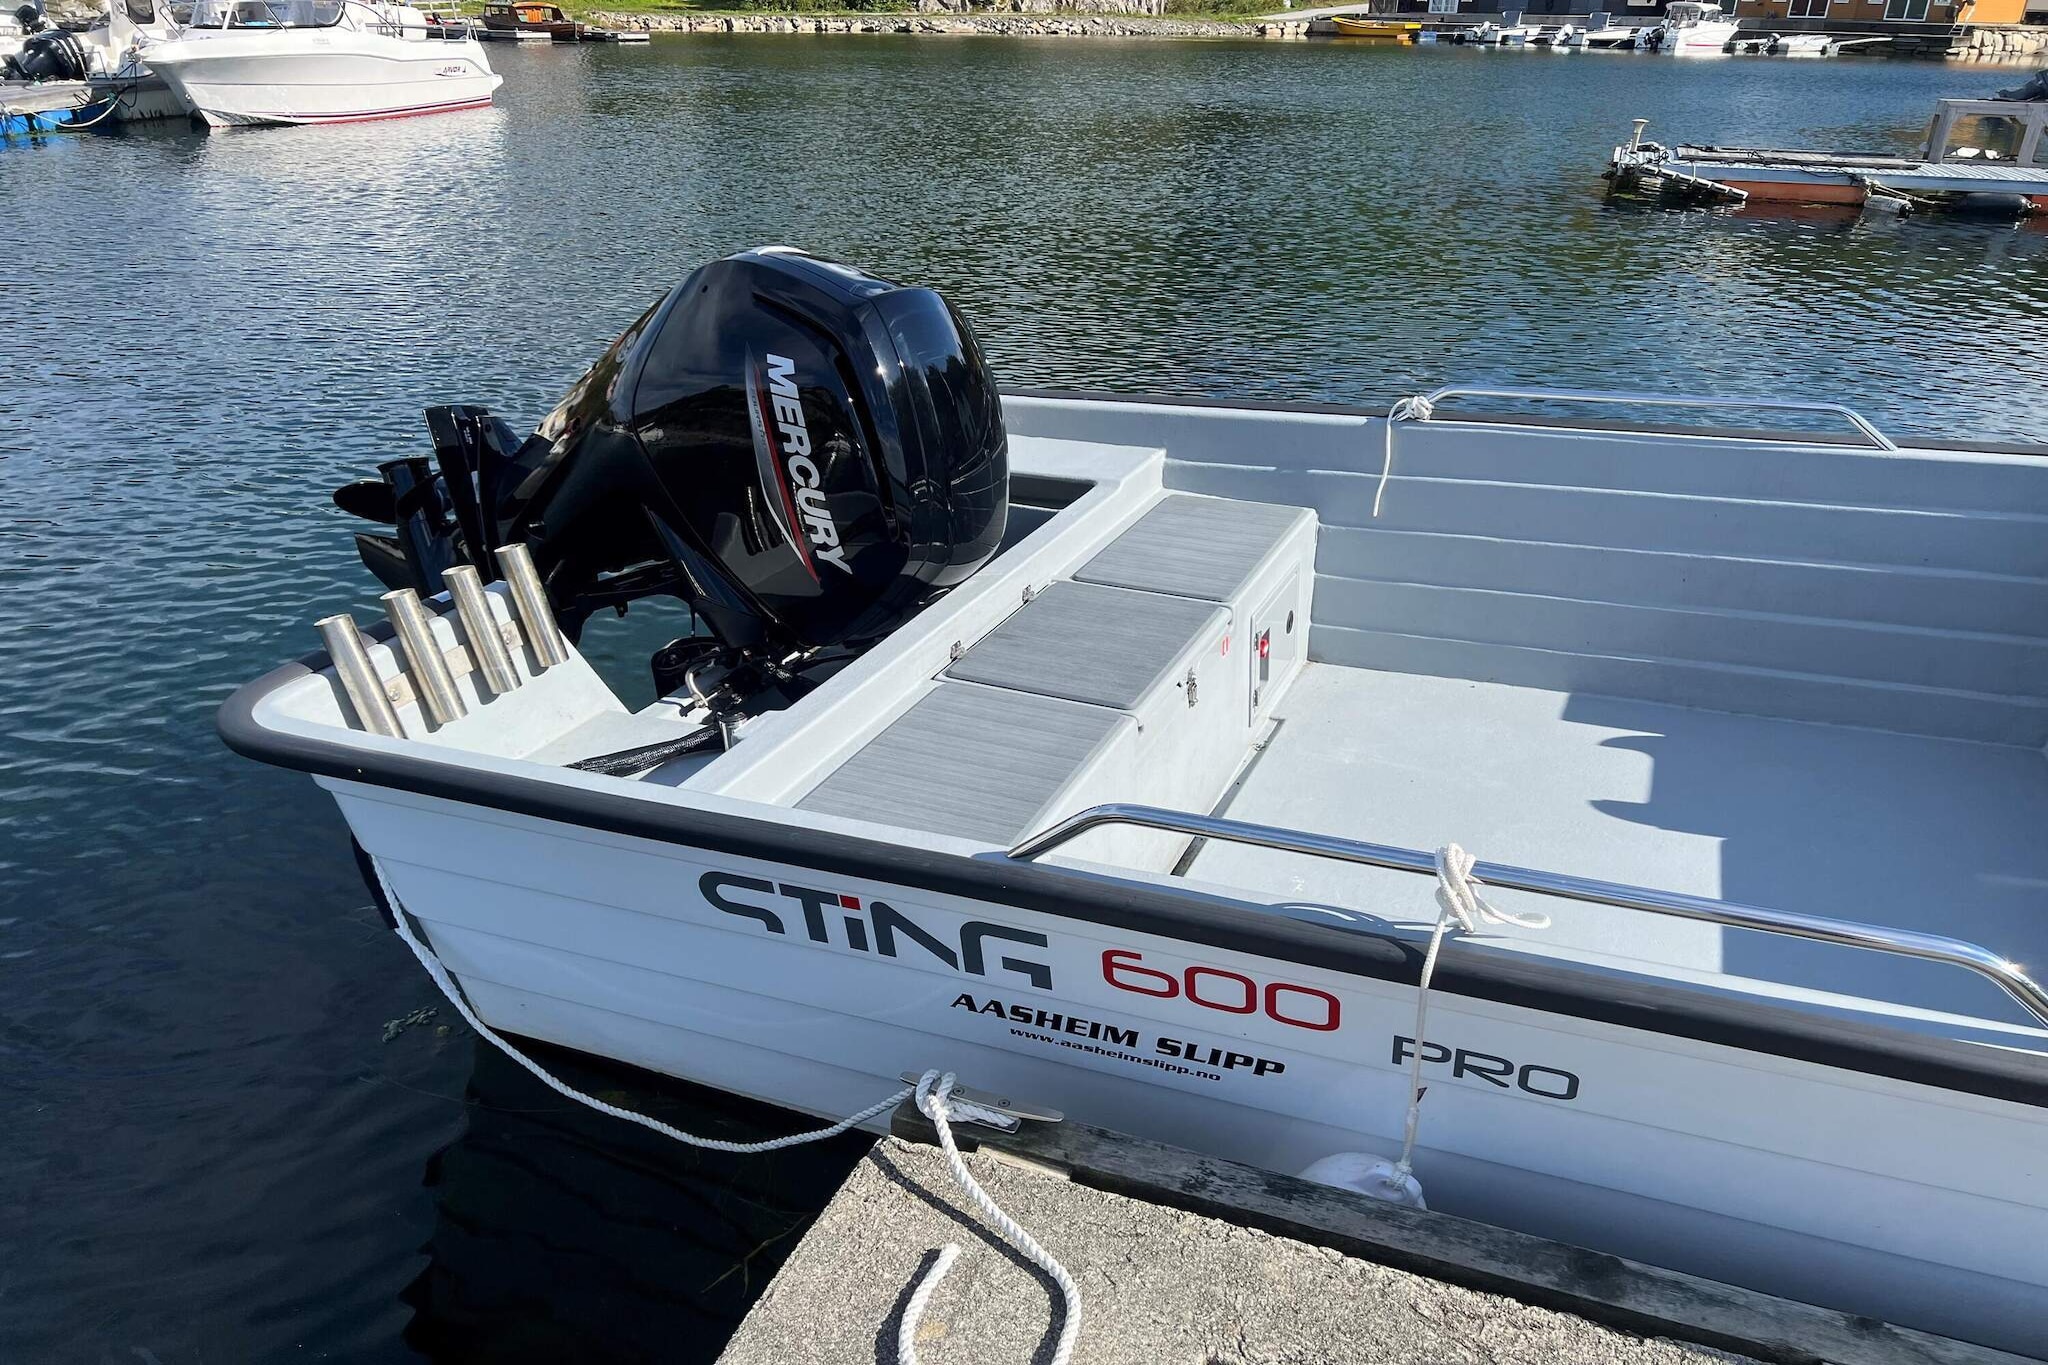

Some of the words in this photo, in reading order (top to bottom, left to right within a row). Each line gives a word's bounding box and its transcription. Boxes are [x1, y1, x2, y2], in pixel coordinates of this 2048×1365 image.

[766, 353, 853, 575] MERCURY
[950, 993, 1139, 1048] AASHEIM
[1155, 1037, 1286, 1077] SLIPP
[1009, 1028, 1221, 1081] www.aasheimslipp.no
[1102, 949, 1341, 1031] 600
[1391, 1035, 1580, 1100] PRO
